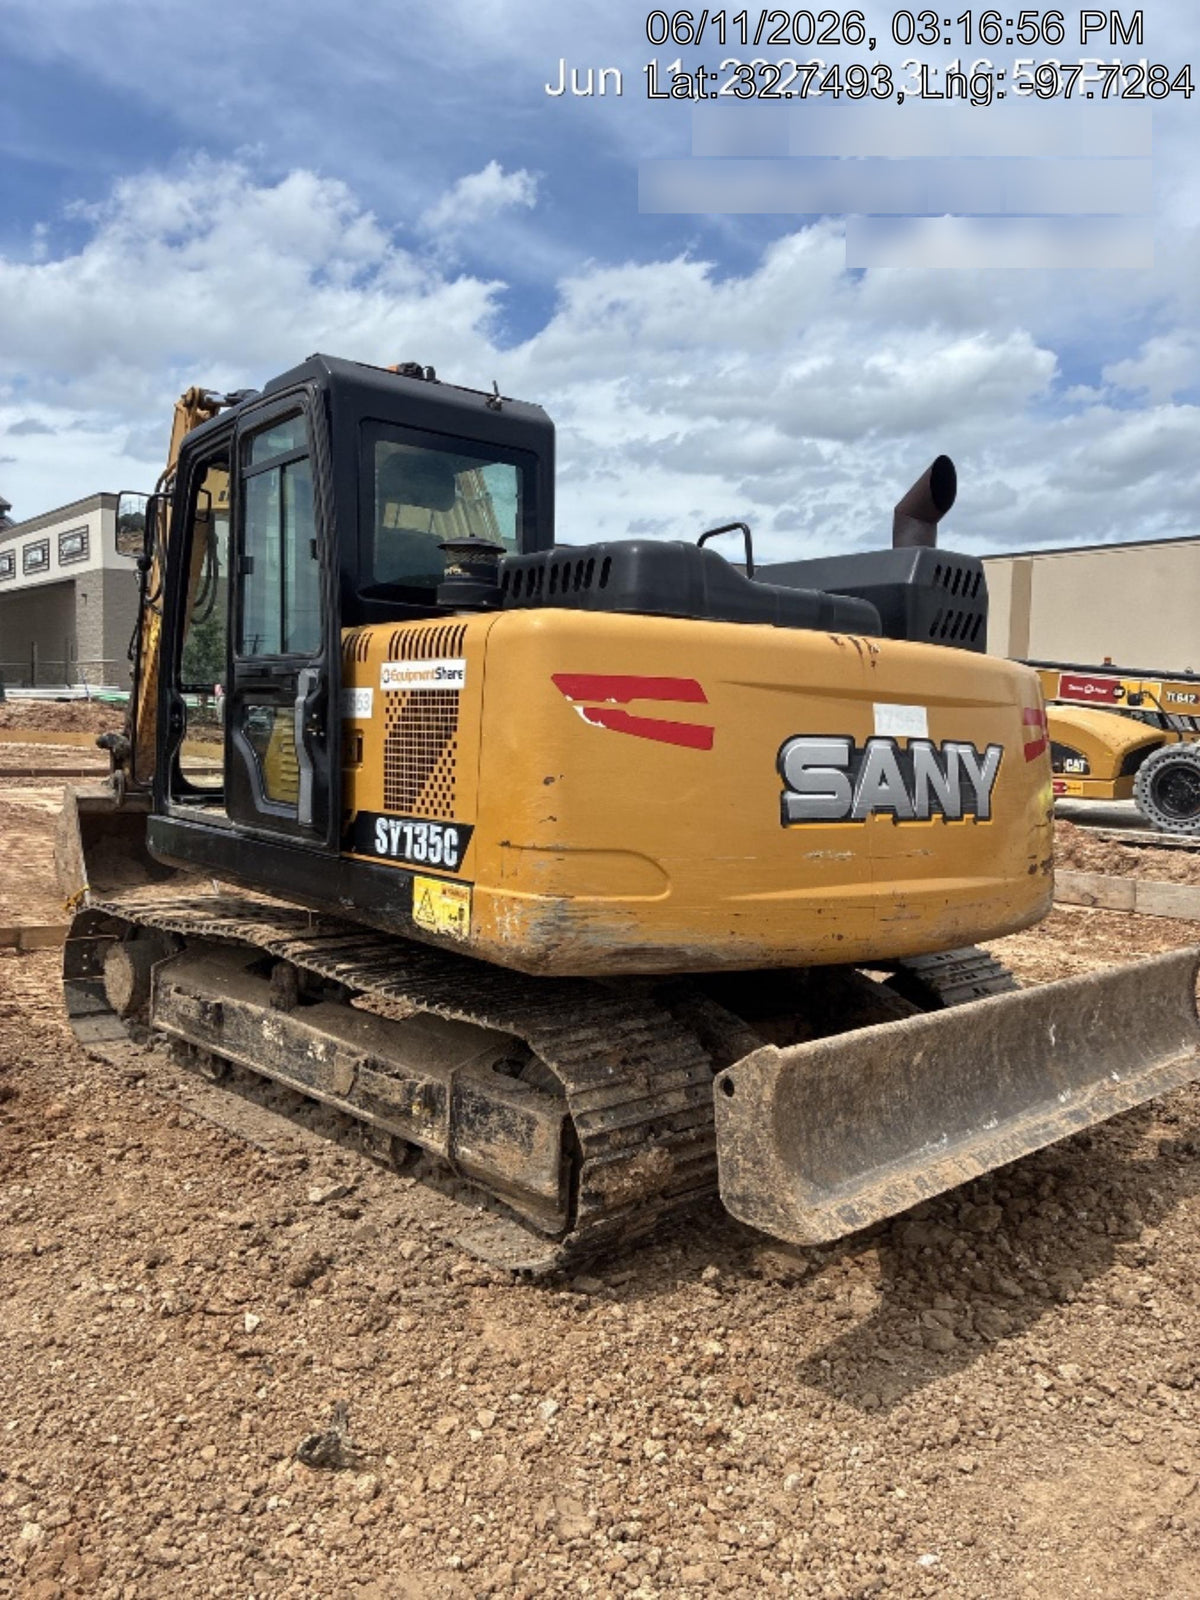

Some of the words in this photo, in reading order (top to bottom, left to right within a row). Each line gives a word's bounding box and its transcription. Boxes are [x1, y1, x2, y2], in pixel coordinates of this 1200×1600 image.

[777, 734, 1004, 828] SANY
[1065, 758, 1087, 773] CAT
[374, 816, 460, 867] SY135C
